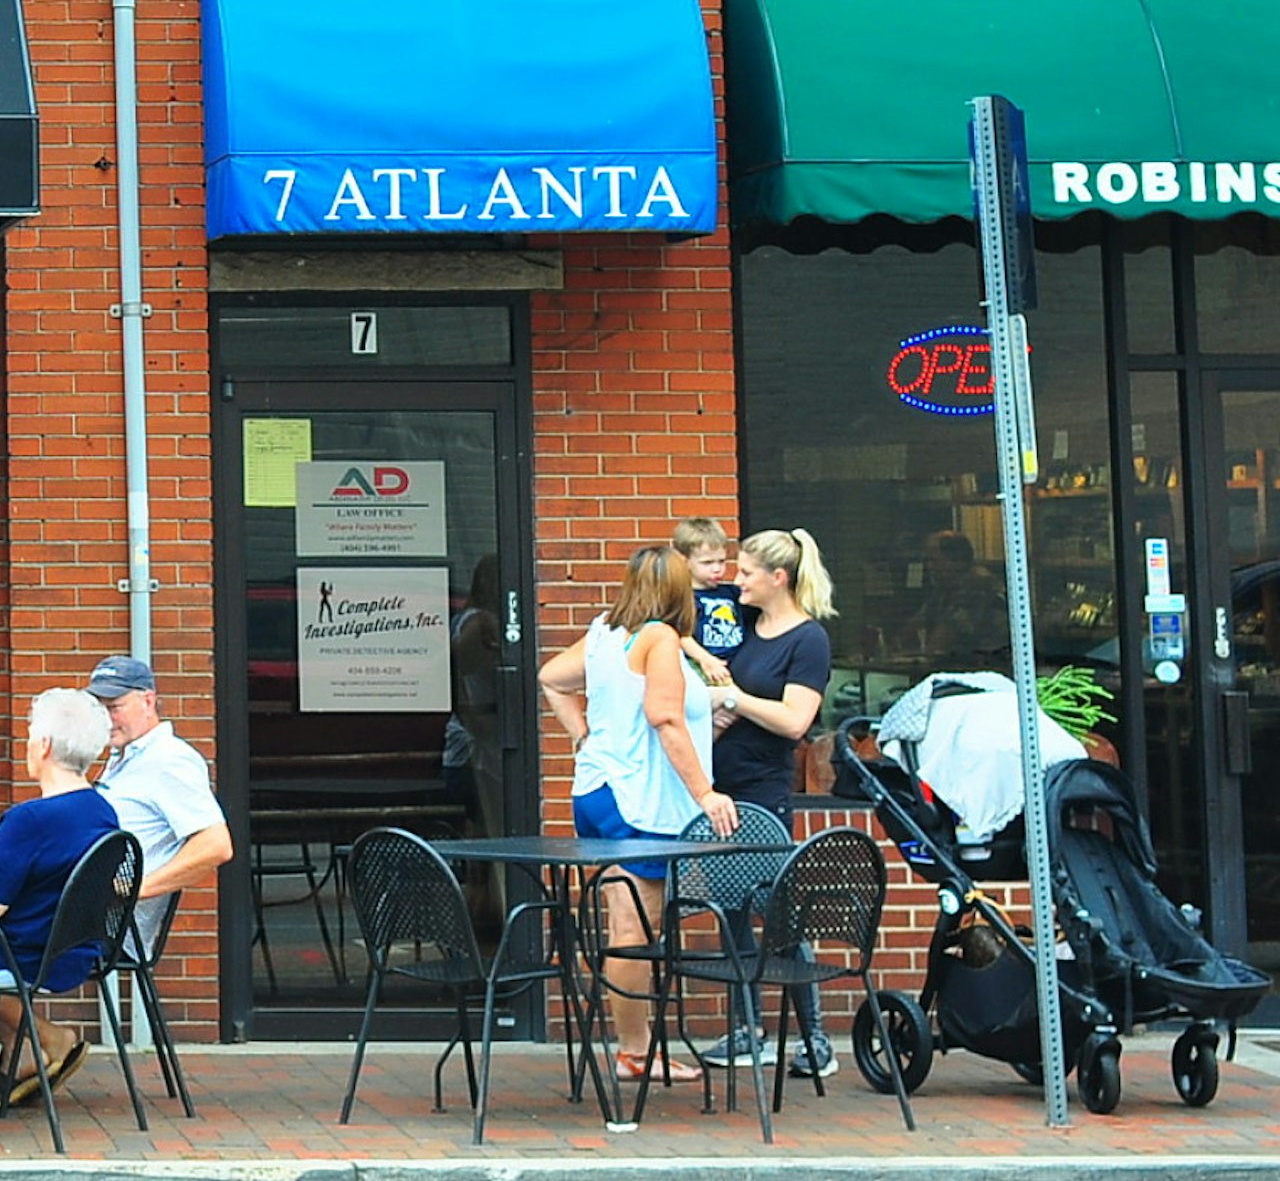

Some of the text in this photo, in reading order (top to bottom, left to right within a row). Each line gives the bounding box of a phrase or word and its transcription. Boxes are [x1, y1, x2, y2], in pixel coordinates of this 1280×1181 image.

[264, 166, 691, 222] 7 ATLANTA
[354, 316, 374, 351] 7
[886, 343, 1033, 395] OPE
[331, 466, 410, 496] AD
[336, 508, 360, 518] LAW
[337, 595, 406, 617] Complete
[415, 611, 444, 628] Inc.
